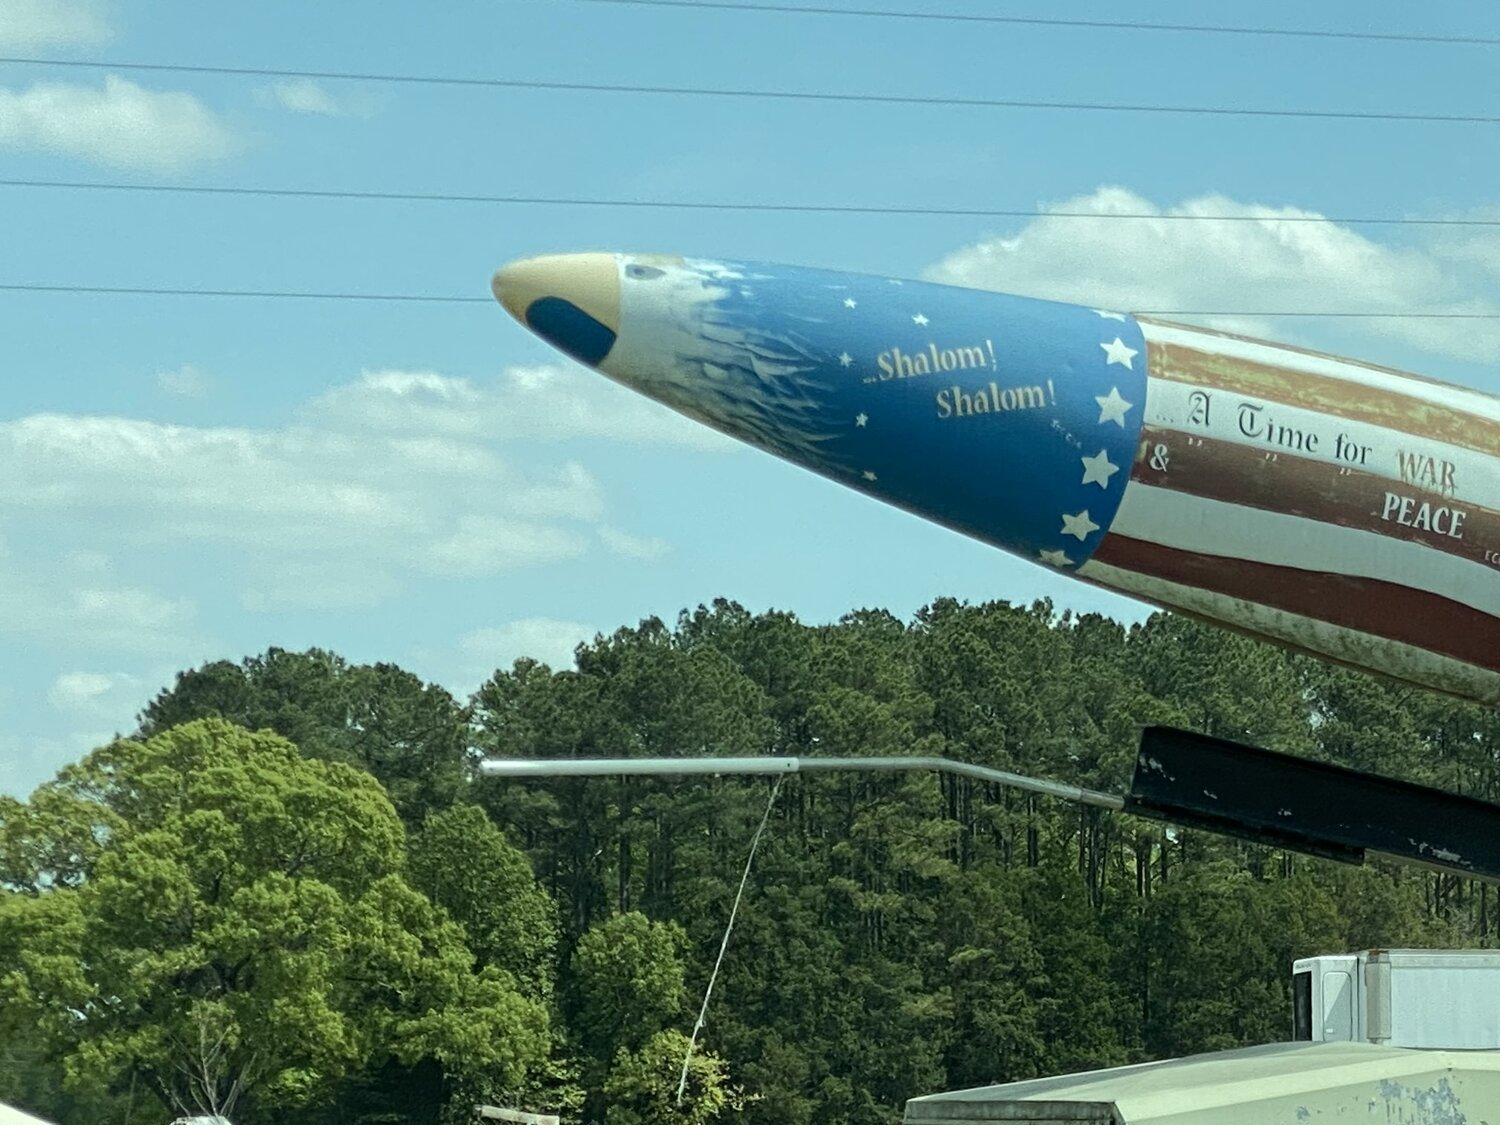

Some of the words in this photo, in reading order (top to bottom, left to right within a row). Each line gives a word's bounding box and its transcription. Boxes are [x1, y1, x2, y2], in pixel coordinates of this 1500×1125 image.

[936, 379, 1056, 418] Shalom!
[1149, 443, 1170, 473] &
[1381, 492, 1467, 539] PEACE
[1237, 402, 1319, 453] Time
[1334, 433, 1373, 465] for
[1395, 449, 1457, 492] WAR
